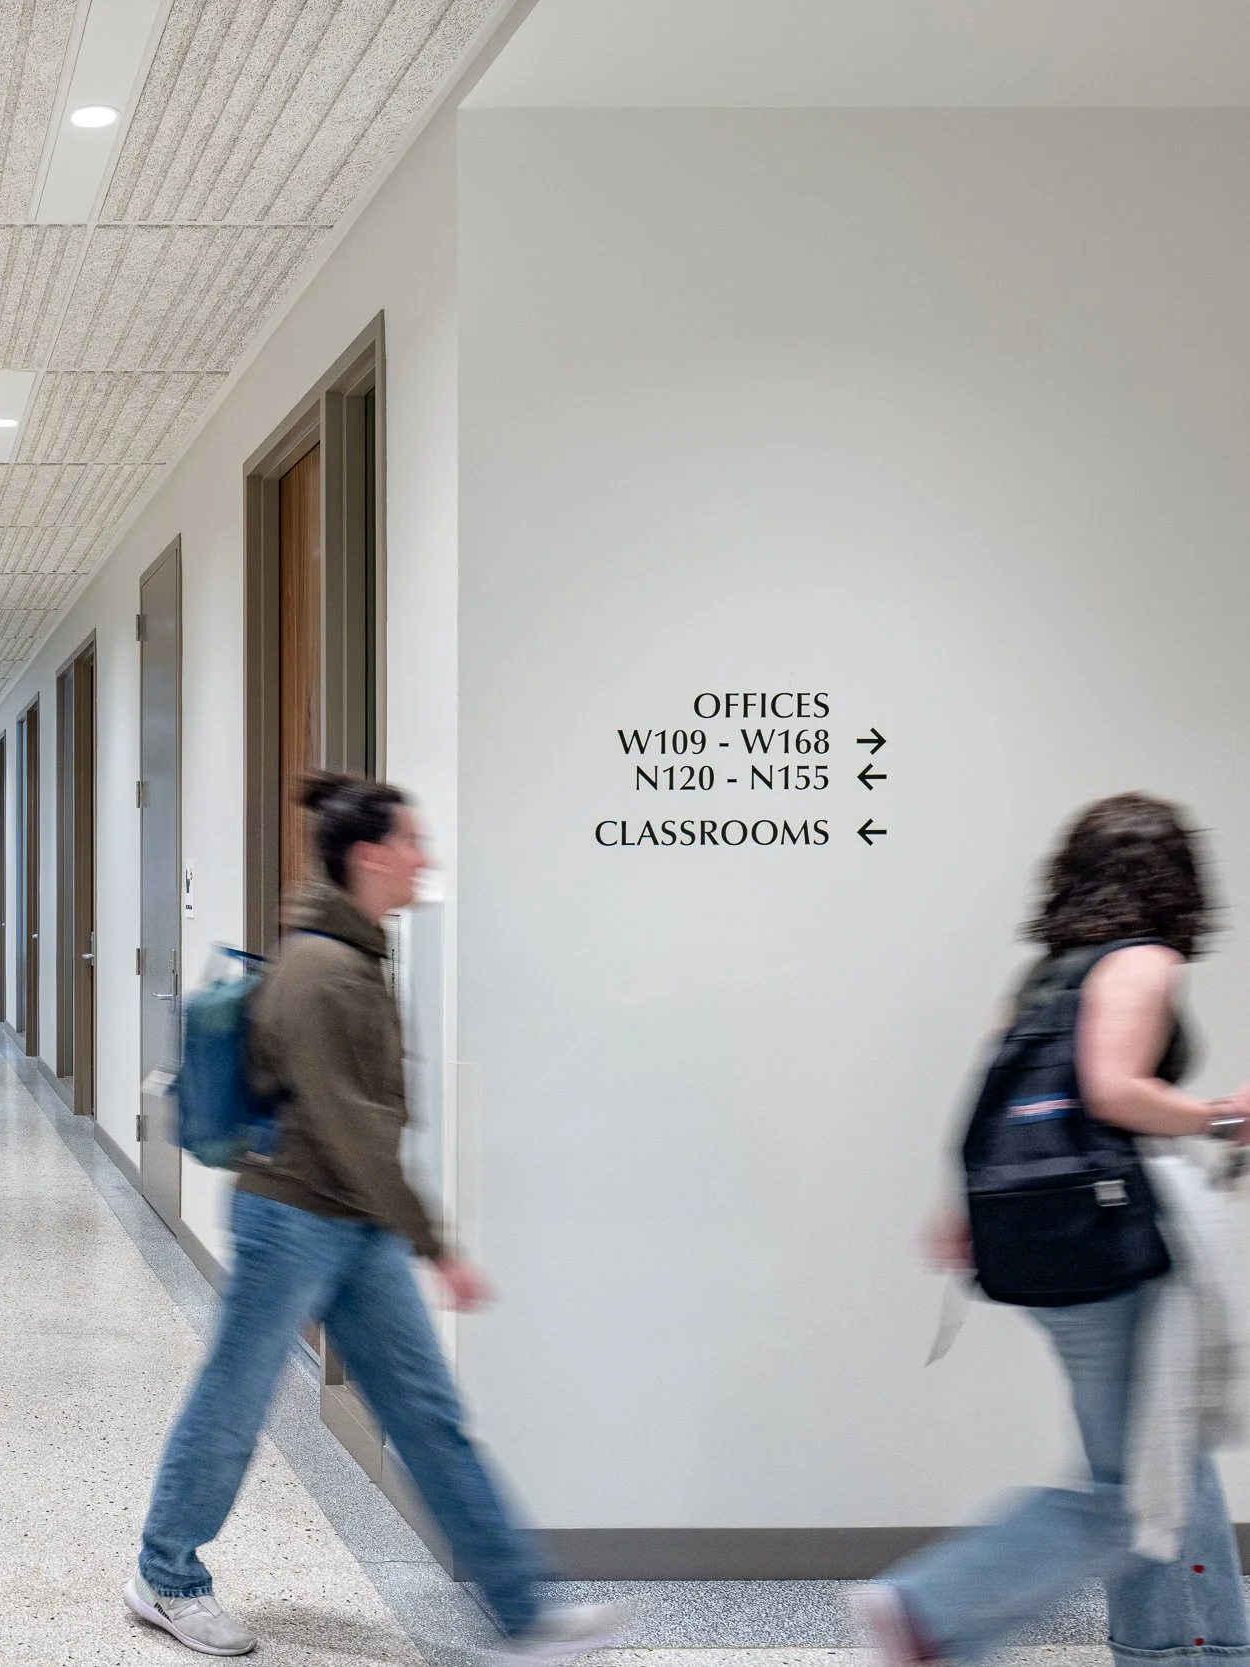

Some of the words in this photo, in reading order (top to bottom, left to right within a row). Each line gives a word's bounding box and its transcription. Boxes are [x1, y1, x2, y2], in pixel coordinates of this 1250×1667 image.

[693, 692, 830, 719] OFFICES
[617, 729, 707, 755] W109
[740, 728, 830, 755] W168
[636, 765, 715, 791] N120
[750, 764, 830, 791] N155
[594, 819, 830, 847] CLASSROOMS
